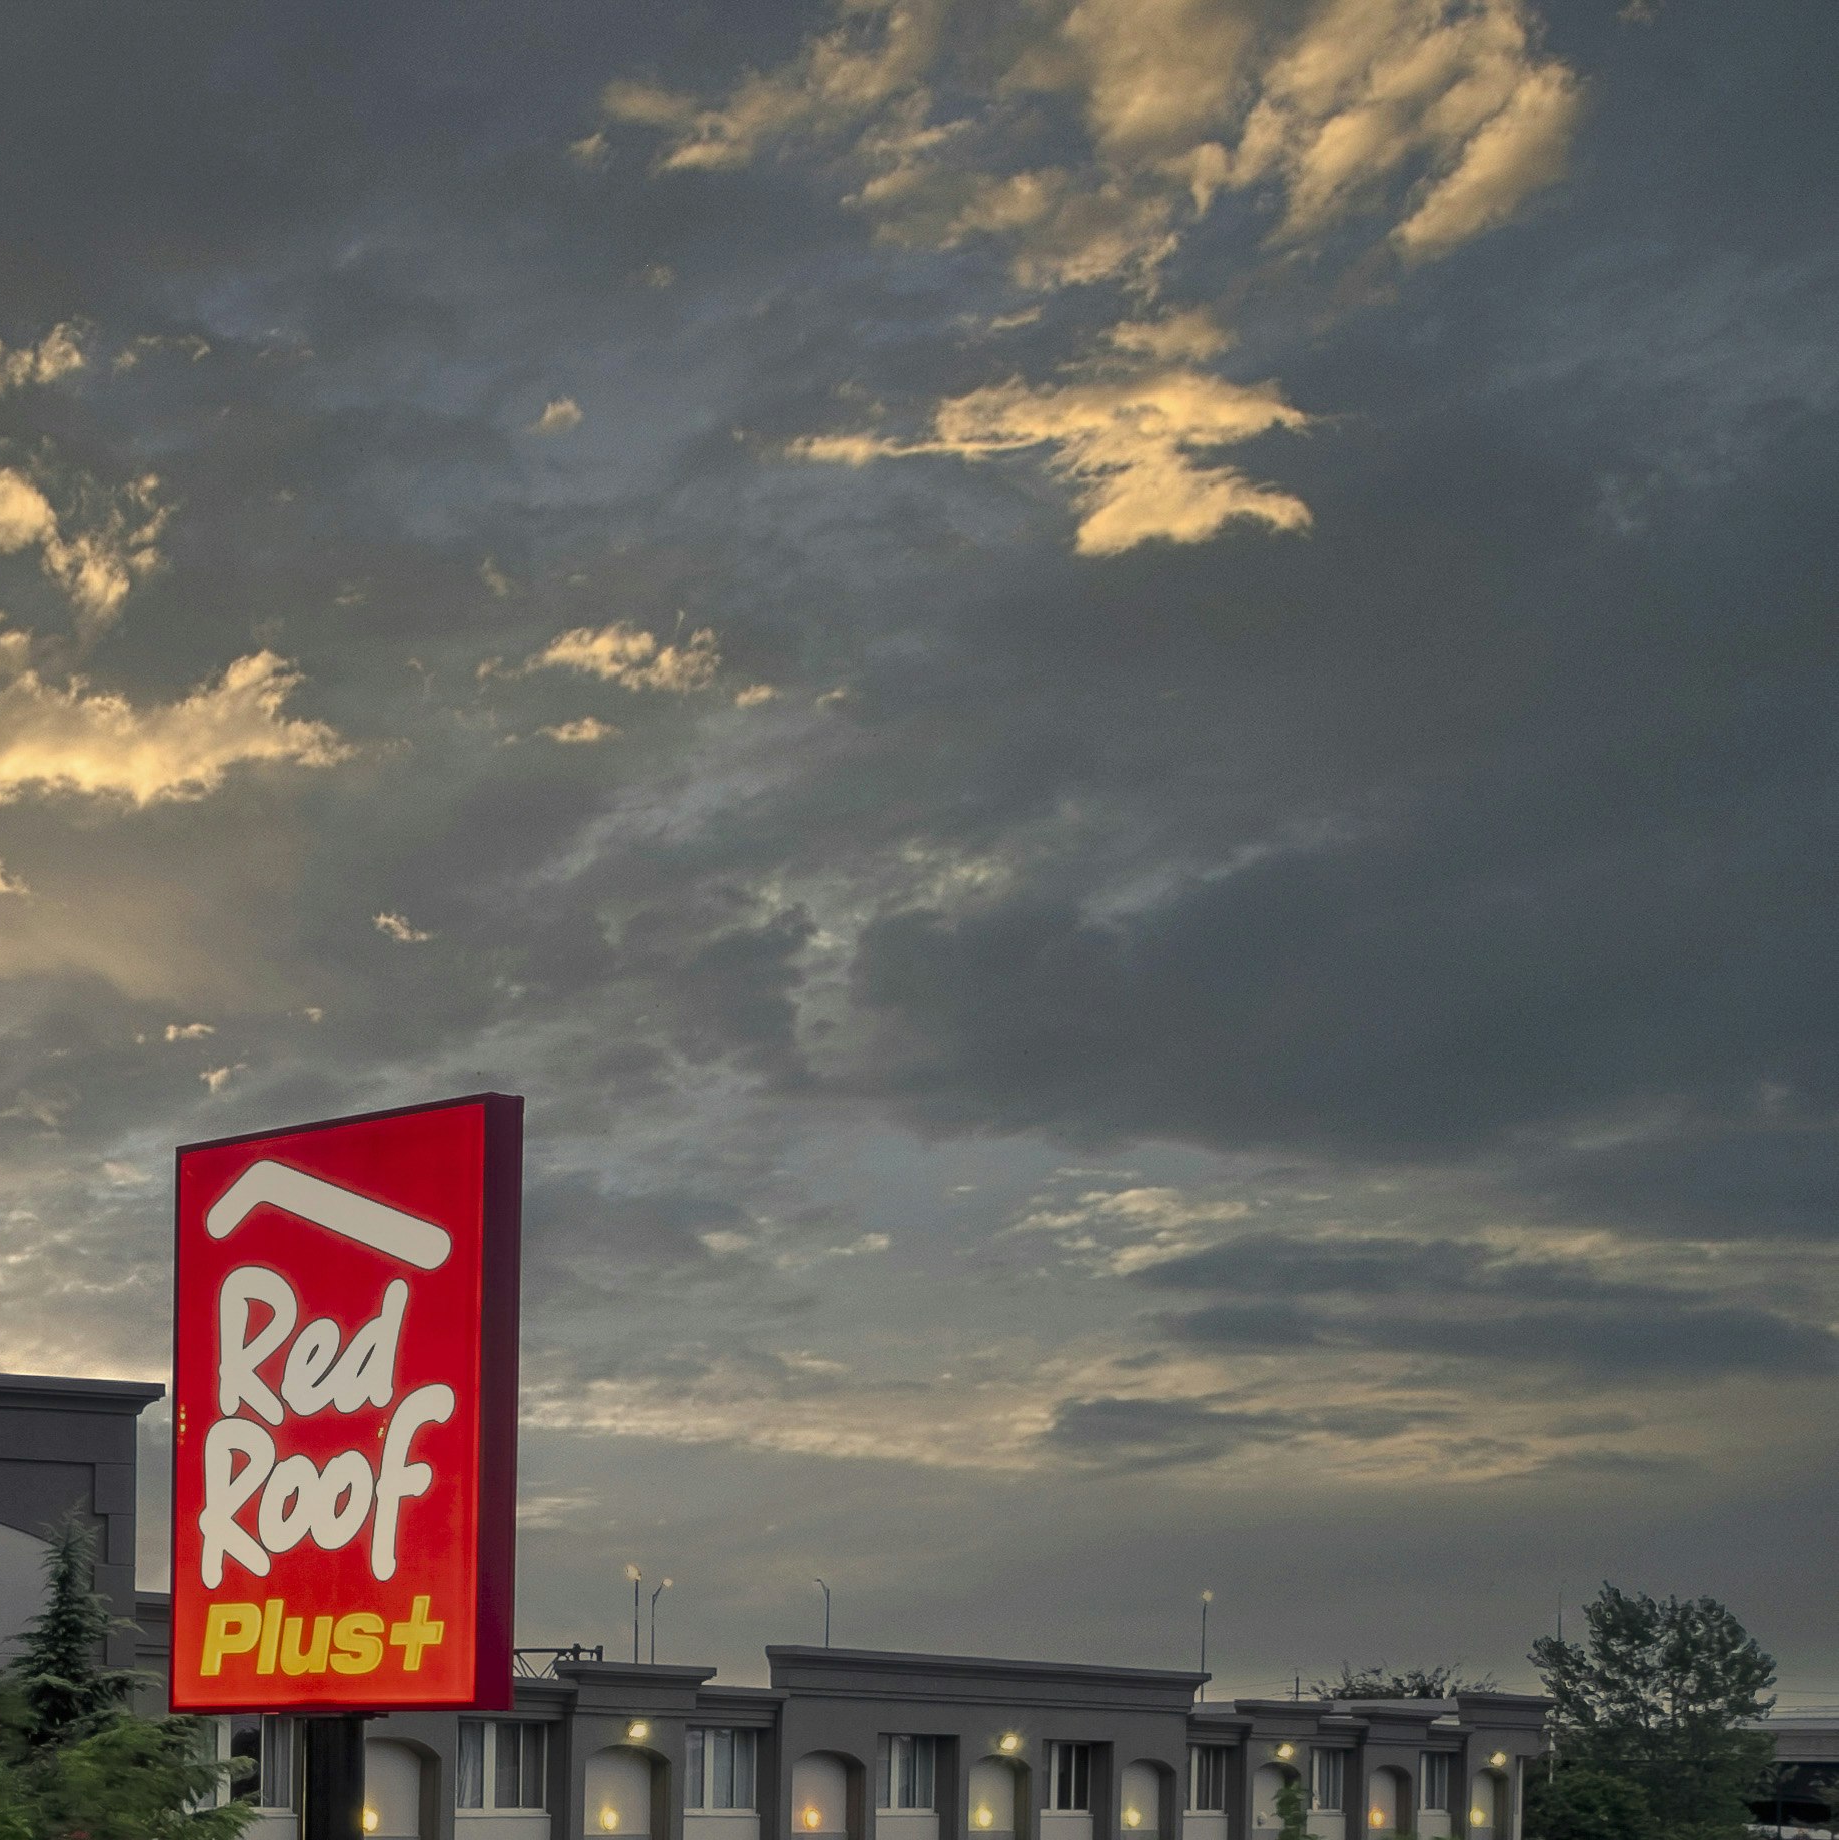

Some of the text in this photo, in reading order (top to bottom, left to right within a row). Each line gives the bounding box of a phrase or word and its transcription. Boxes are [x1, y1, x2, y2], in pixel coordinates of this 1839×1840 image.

[219, 1266, 409, 1426] Red
[198, 1384, 455, 1590] Roof
[199, 1595, 445, 1676] Plus+
